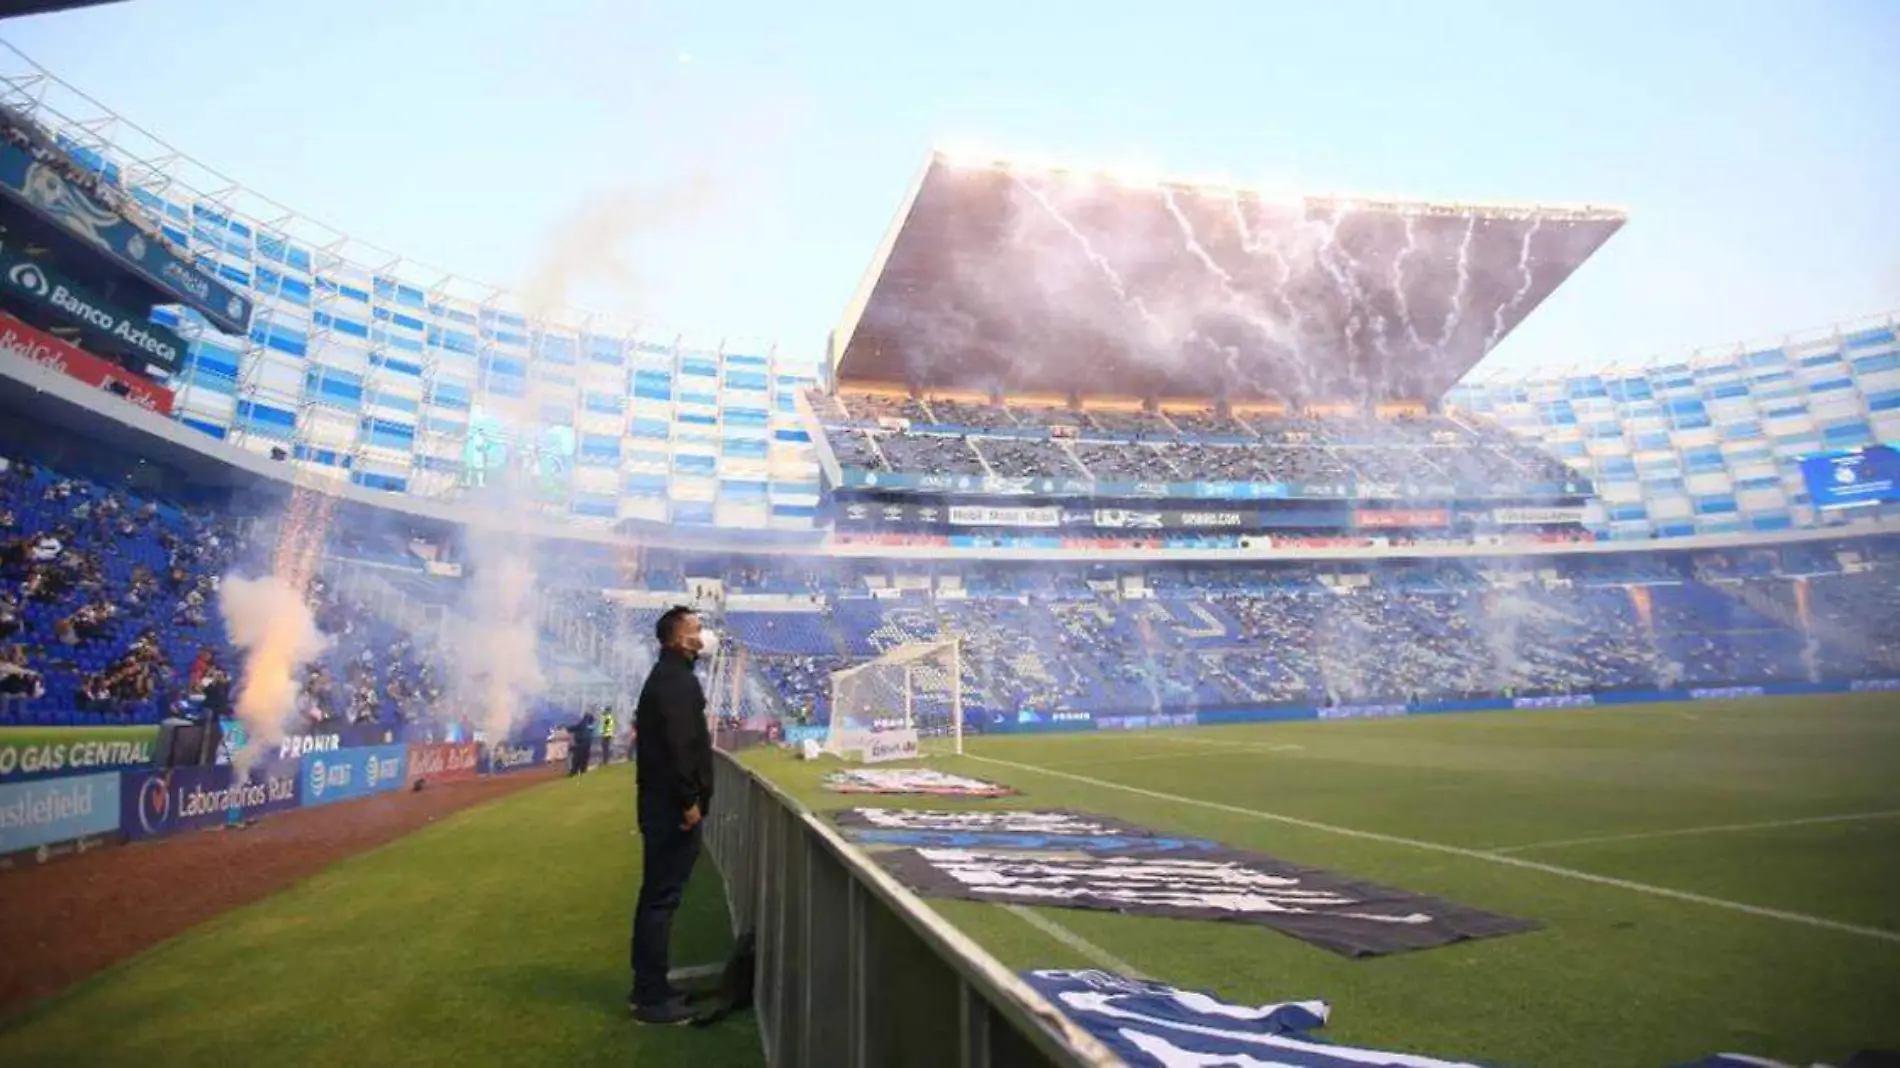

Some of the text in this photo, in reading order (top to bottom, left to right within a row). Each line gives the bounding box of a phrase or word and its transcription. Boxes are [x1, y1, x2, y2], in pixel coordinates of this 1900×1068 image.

[52, 285, 176, 361] Banco Azteca
[21, 744, 66, 773] GAS
[69, 740, 150, 767] CENTRAL
